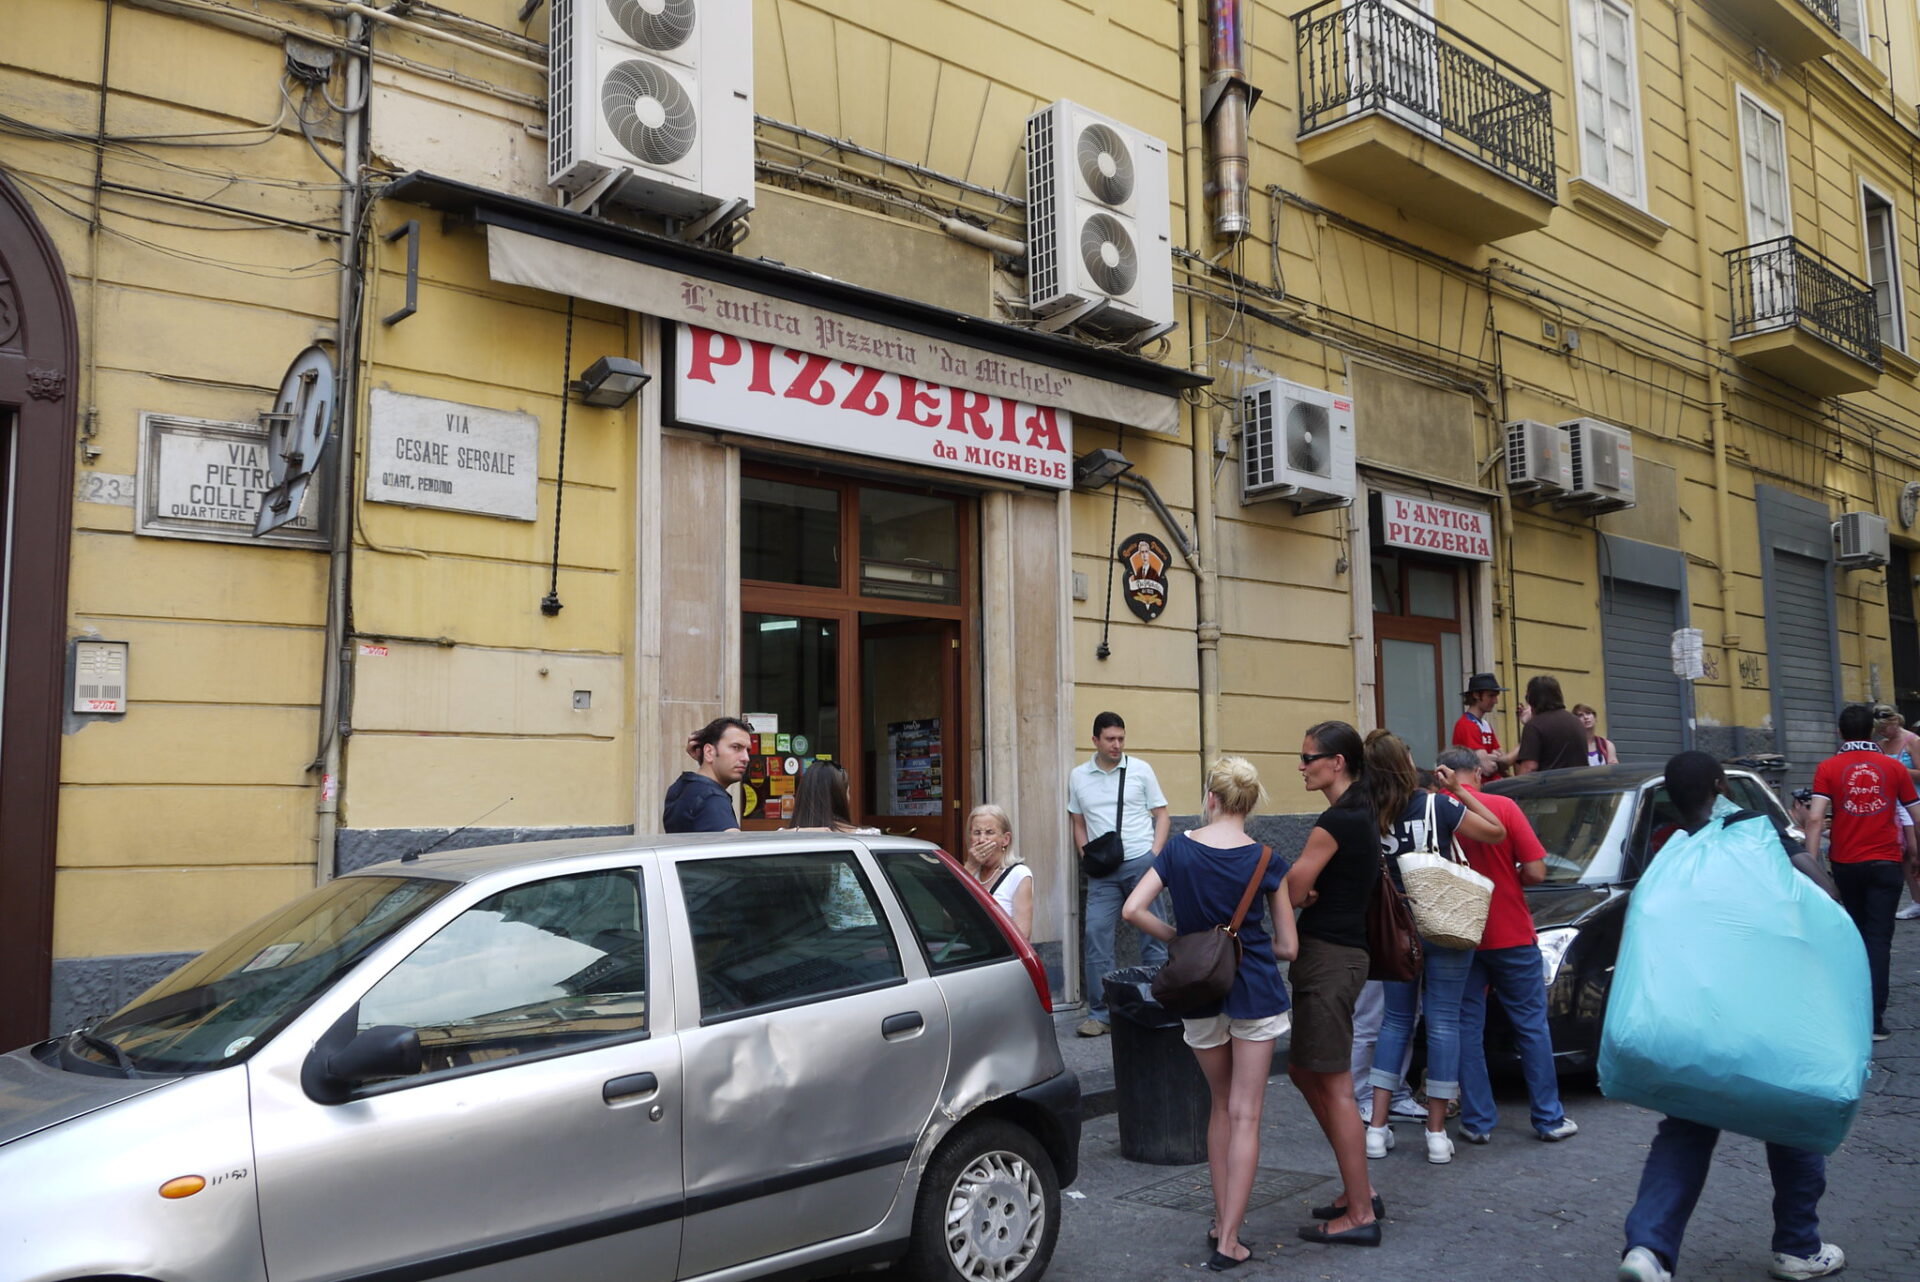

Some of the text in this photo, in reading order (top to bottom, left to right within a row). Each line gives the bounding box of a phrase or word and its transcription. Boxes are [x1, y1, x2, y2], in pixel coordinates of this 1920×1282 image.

[681, 282, 1072, 397] L'antica Pizzeria "da Michele"
[687, 325, 1067, 453] PIZZERIA
[446, 413, 469, 434] VIA
[227, 443, 258, 467] VIA
[396, 437, 515, 476] CESARE SERSALE
[932, 440, 1067, 480] da MICHELE
[89, 476, 120, 500] 23
[171, 504, 247, 522] QUARTIERE
[1395, 499, 1482, 534] L'ANTICA
[1388, 521, 1490, 557] PIZZERIA
